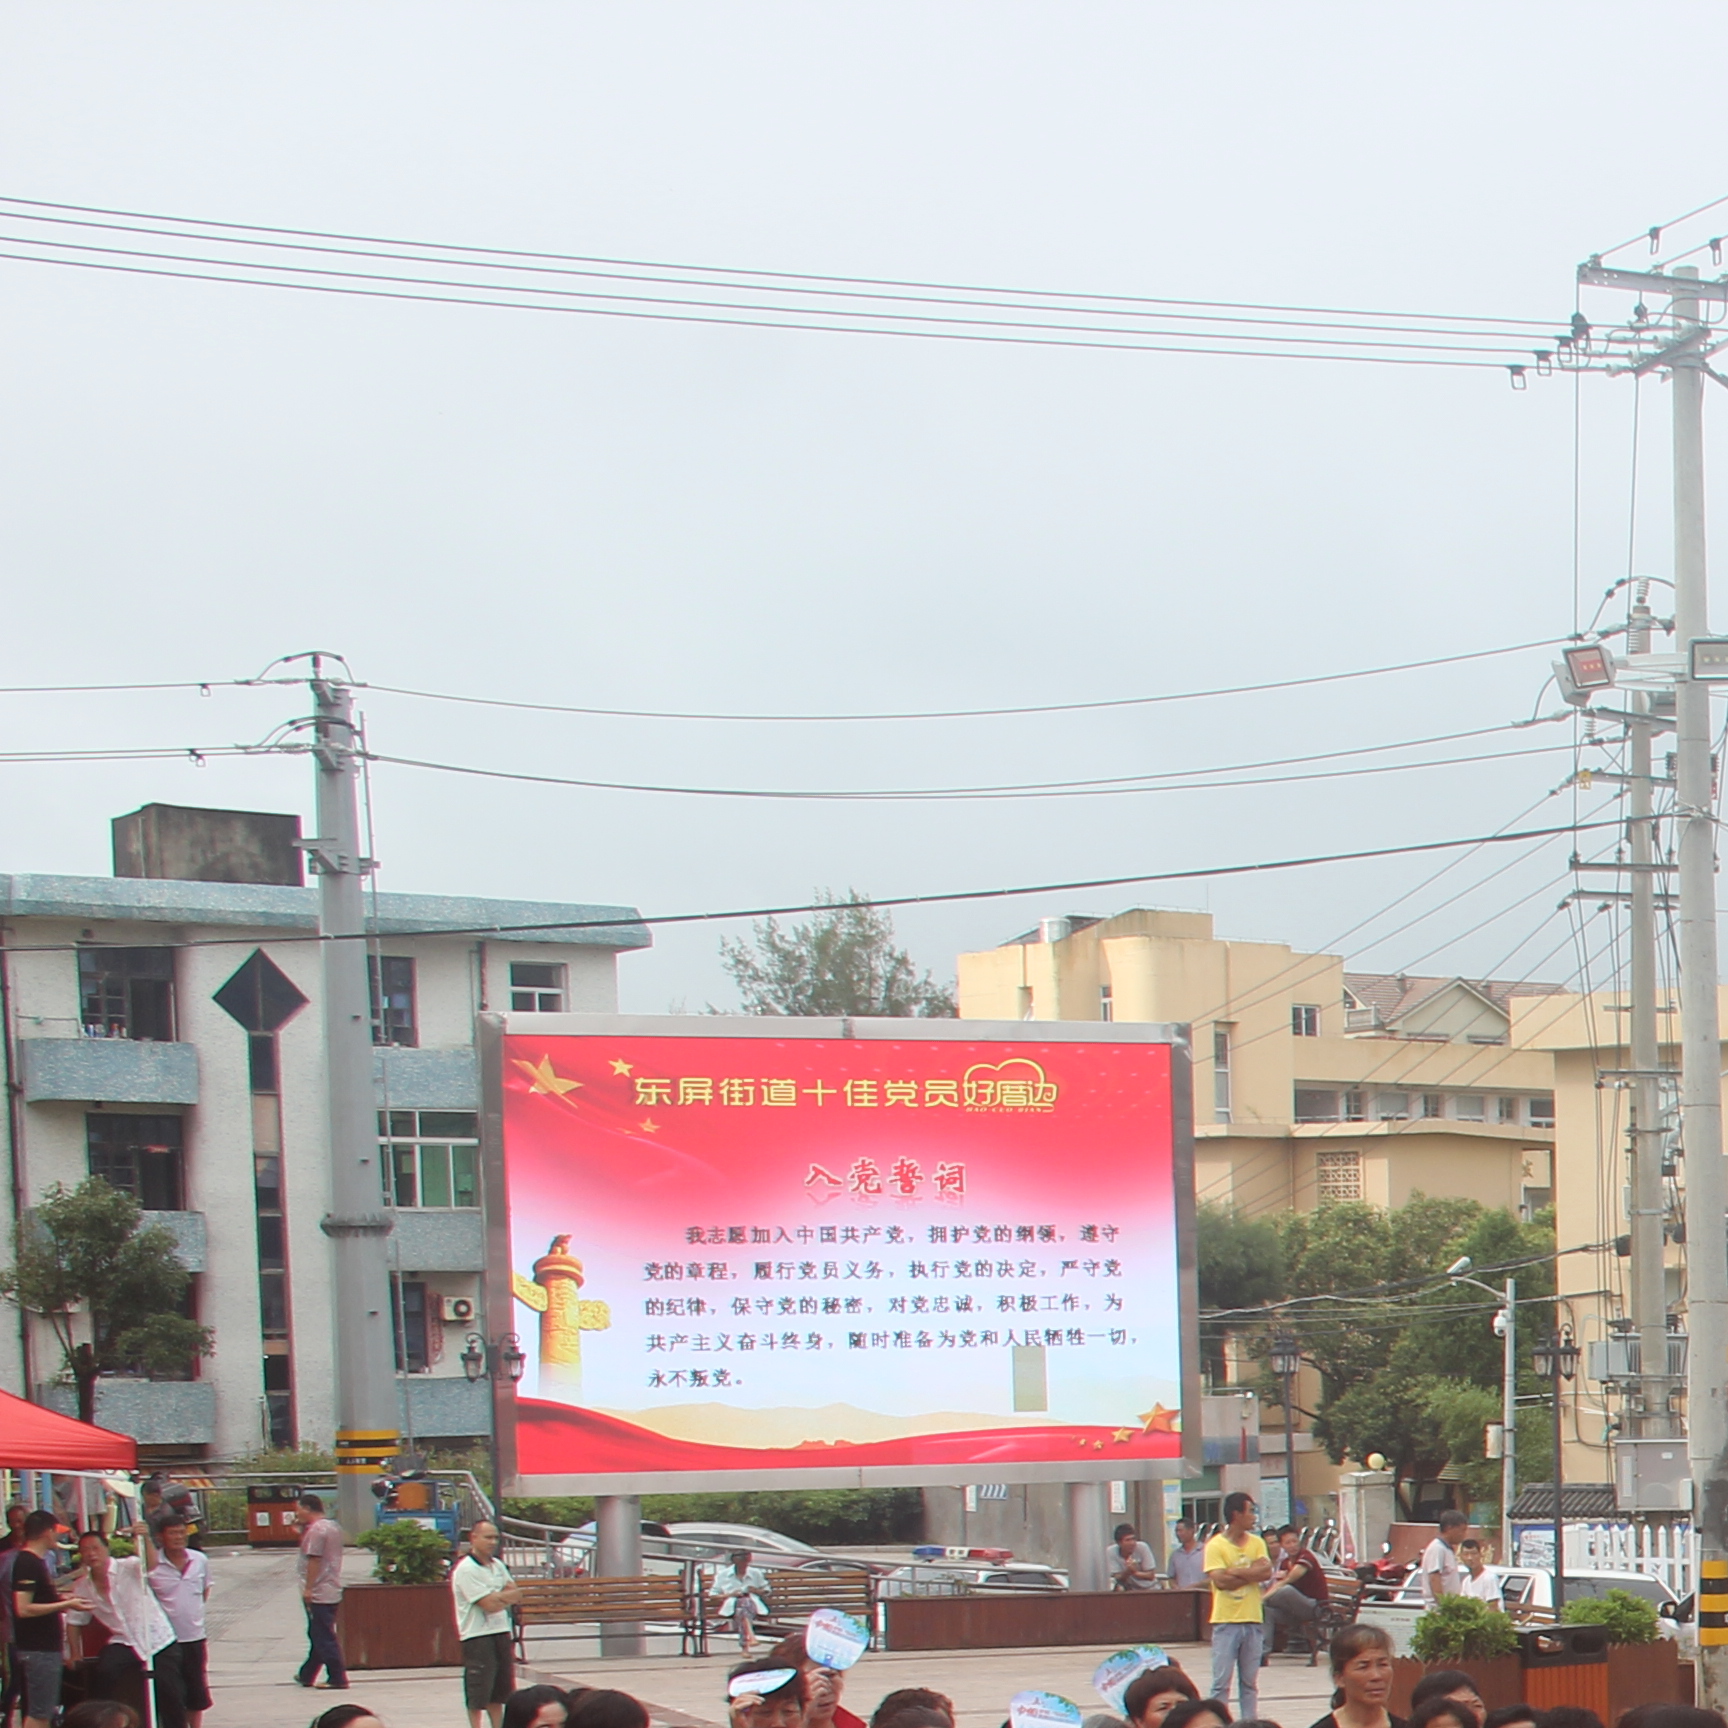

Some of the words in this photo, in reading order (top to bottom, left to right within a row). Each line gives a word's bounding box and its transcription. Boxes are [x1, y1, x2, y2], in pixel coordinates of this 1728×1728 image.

[804, 1156, 967, 1195] 入党誓词
[647, 1367, 744, 1389] 永不叛党。
